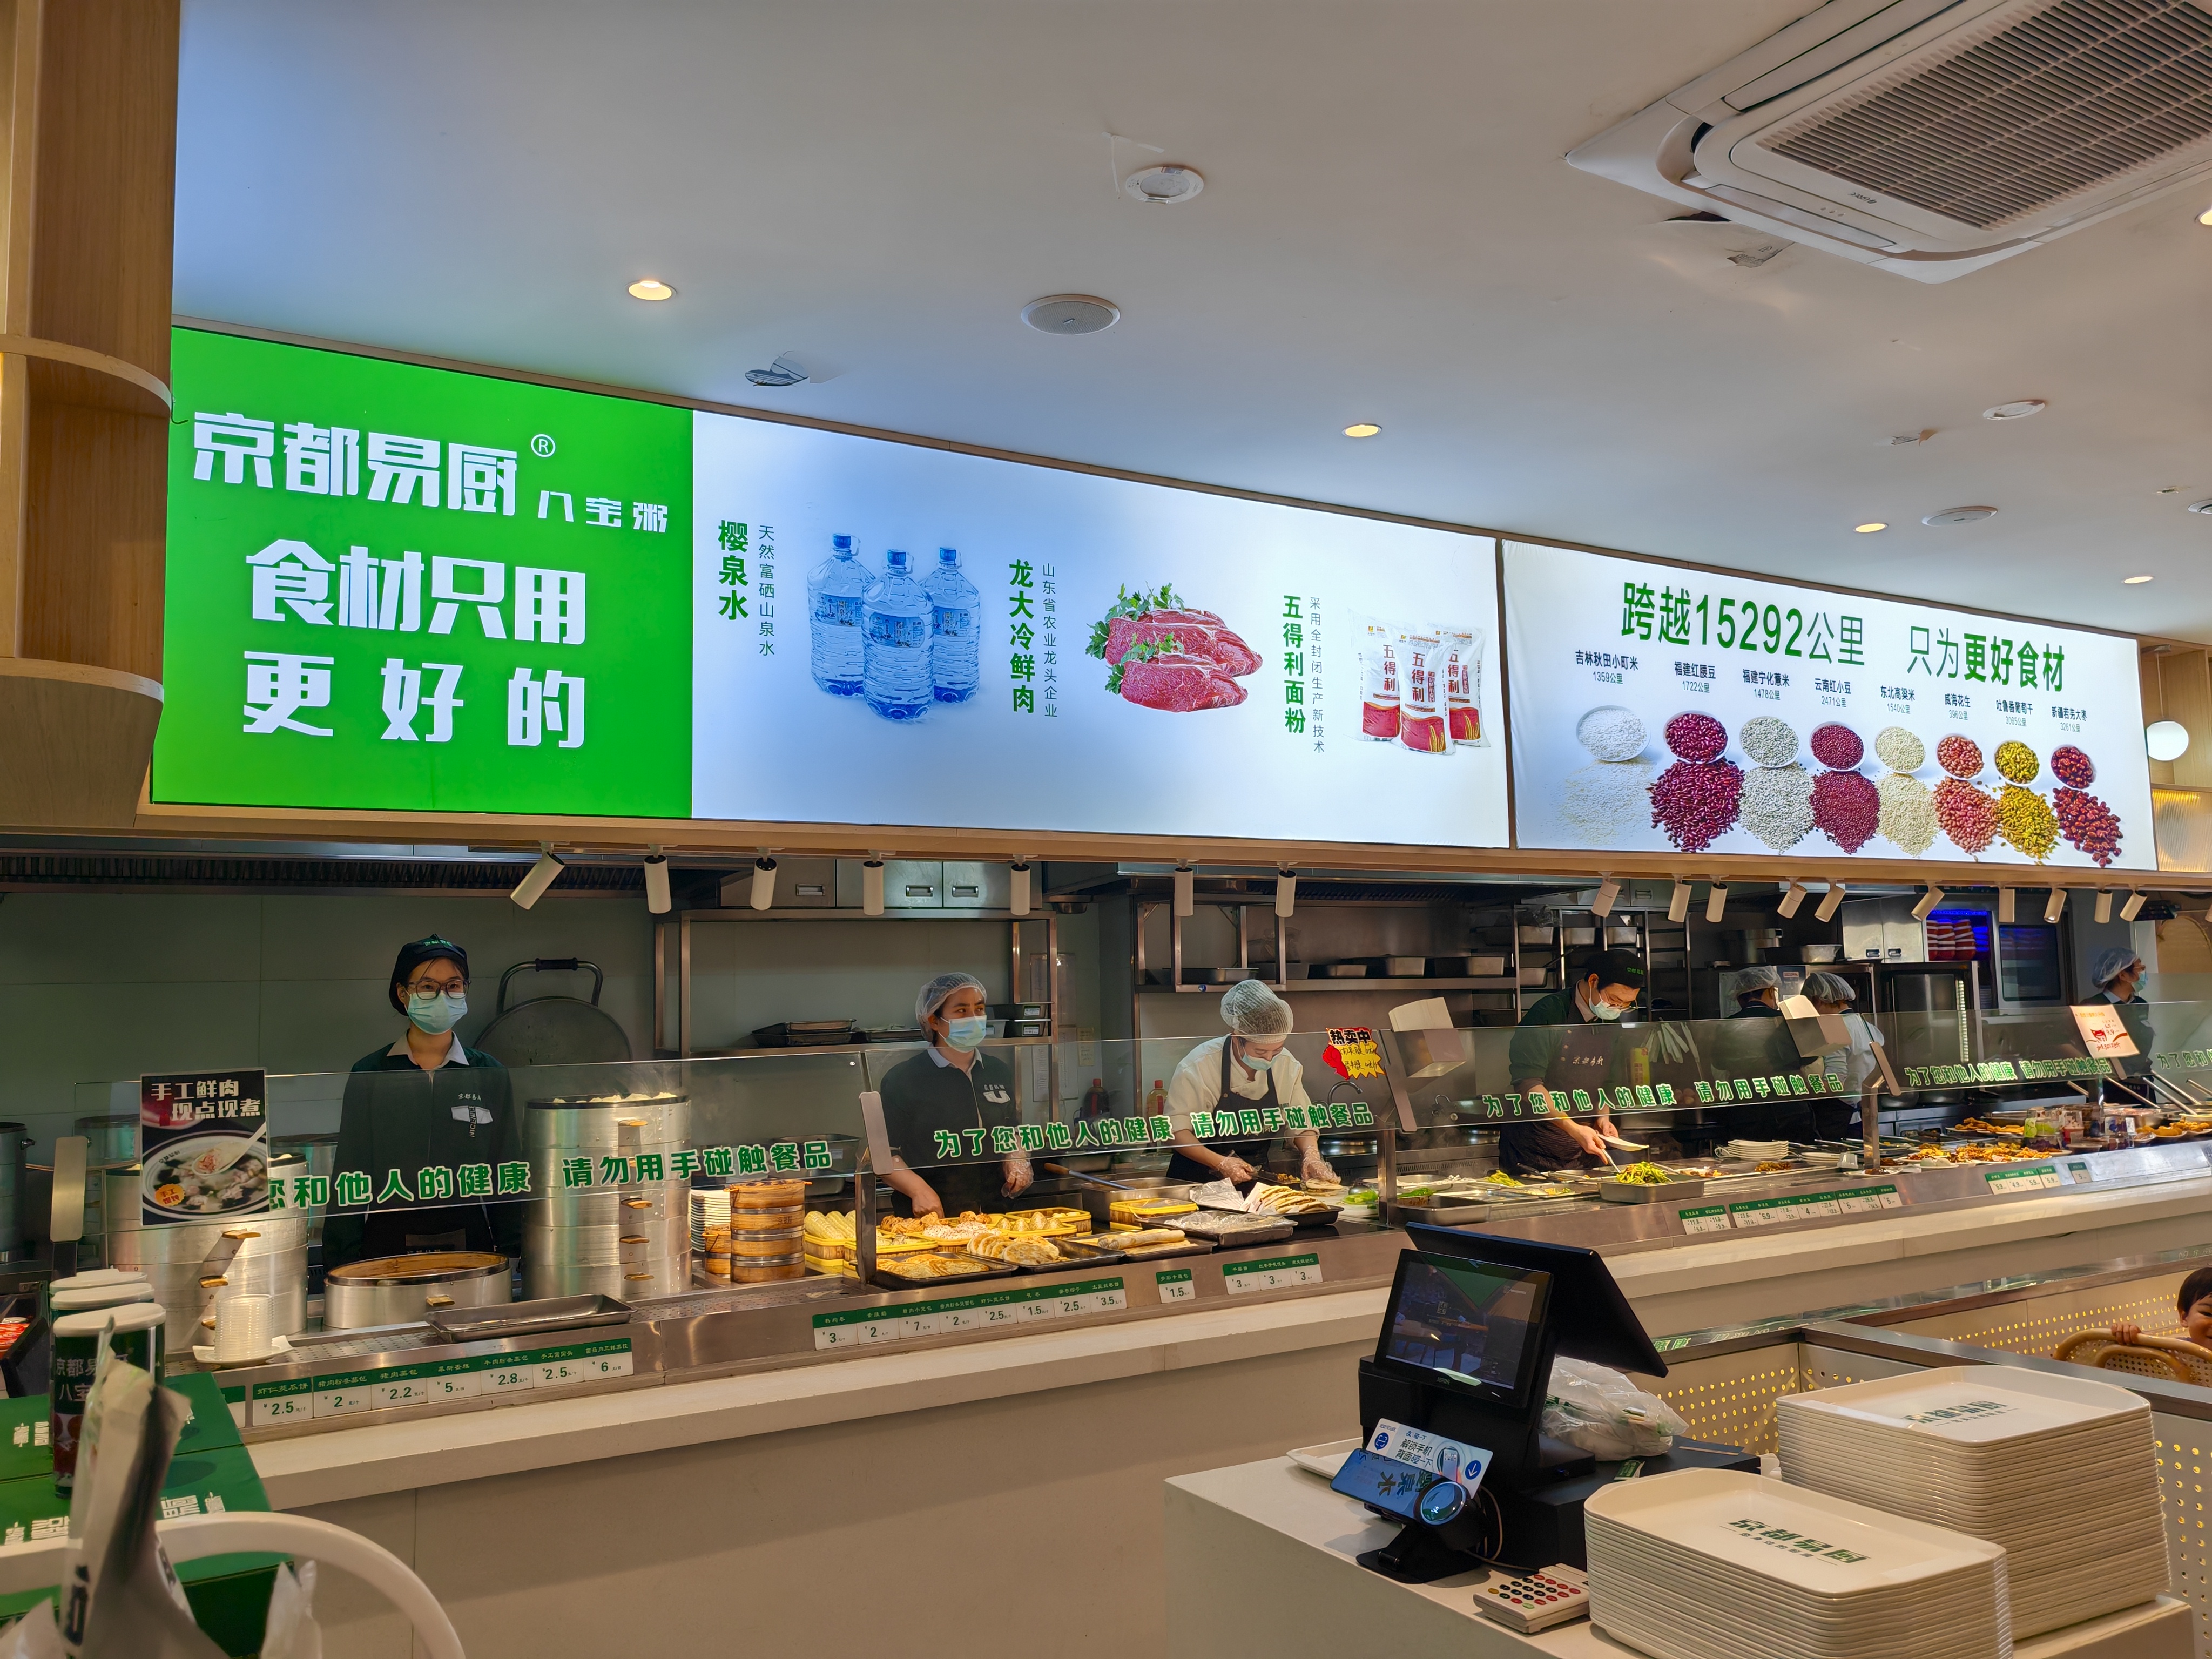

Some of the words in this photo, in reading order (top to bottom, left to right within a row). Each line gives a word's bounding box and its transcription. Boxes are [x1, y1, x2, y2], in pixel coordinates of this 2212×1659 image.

[194, 412, 517, 515] 京都易厨
[538, 490, 667, 533] 八宝粥
[718, 520, 749, 621] 樱泉水
[246, 539, 586, 645] 食材只用
[759, 524, 775, 656] 天然富硒山泉水
[1009, 559, 1035, 714] 龙大冷鲜肉
[1042, 563, 1058, 718] 山东省农业龙头企业
[1621, 582, 1865, 666] 跨越15292公里
[1907, 625, 2065, 693] 只为更好食材
[1283, 595, 1305, 733] 五得利面粉
[1383, 644, 1396, 691] 五得利
[1575, 650, 1638, 671] 吉林秋田小町米
[1310, 597, 1324, 753] 采用全封闭生产新技术
[1411, 652, 1425, 703] 五得利
[1593, 672, 1623, 684] 1359公里
[1674, 661, 1716, 679] 福建红腰豆
[1743, 669, 1790, 687] 福建宁化薏米
[1682, 681, 1710, 693] 1722公里
[1815, 678, 1851, 694] 云南红小豆
[244, 651, 585, 748] 更好的
[1754, 689, 1781, 700] 1478公里
[1822, 696, 1847, 707] 2471公里
[1944, 693, 1971, 708] 威海花生
[1887, 703, 1911, 714] 1540公里
[1949, 710, 1968, 720] 396公里
[1996, 699, 2033, 715] 吐鲁番葡萄干
[1330, 1029, 1372, 1046] 热卖中
[1905, 1061, 2018, 1087] 为了您和他人的健康
[2020, 1057, 2112, 1080] 请勿用手碰触餐品
[151, 1080, 239, 1101] 手工鲜肉
[1482, 1084, 1676, 1118] 为了您和他人的健康
[1695, 1073, 1844, 1102] 请勿用手碰触餐品
[172, 1098, 260, 1121] 现点现煮
[934, 1115, 1175, 1159] 为了您和他人的健康
[1190, 1102, 1373, 1139] 请勿用手碰触餐品
[562, 1141, 832, 1189] 请勿用手碰触餐品
[1236, 1280, 1242, 1288] 3
[1269, 1276, 1275, 1285] 3
[1300, 1272, 1306, 1280] 3
[1170, 1287, 1184, 1298] 1.5
[1028, 1305, 1042, 1316] 1.5
[1064, 1301, 1080, 1312] 2.5
[953, 1316, 960, 1325] 2
[989, 1311, 1004, 1321] 2.5
[870, 1327, 878, 1338] 2
[914, 1321, 920, 1331] 7
[829, 1332, 837, 1343] 3
[545, 1367, 568, 1380] 2.5
[601, 1362, 609, 1372] 6
[498, 1373, 518, 1385] 2.8
[389, 1386, 412, 1400] 2.2
[445, 1382, 453, 1393] 5
[271, 1401, 294, 1415] 2.5
[334, 1396, 343, 1407] 2
[1400, 1439, 1433, 1456] 解锁手机
[1395, 1449, 1433, 1468] 背面碰一下
[1727, 1519, 1872, 1564] 京都易厨
